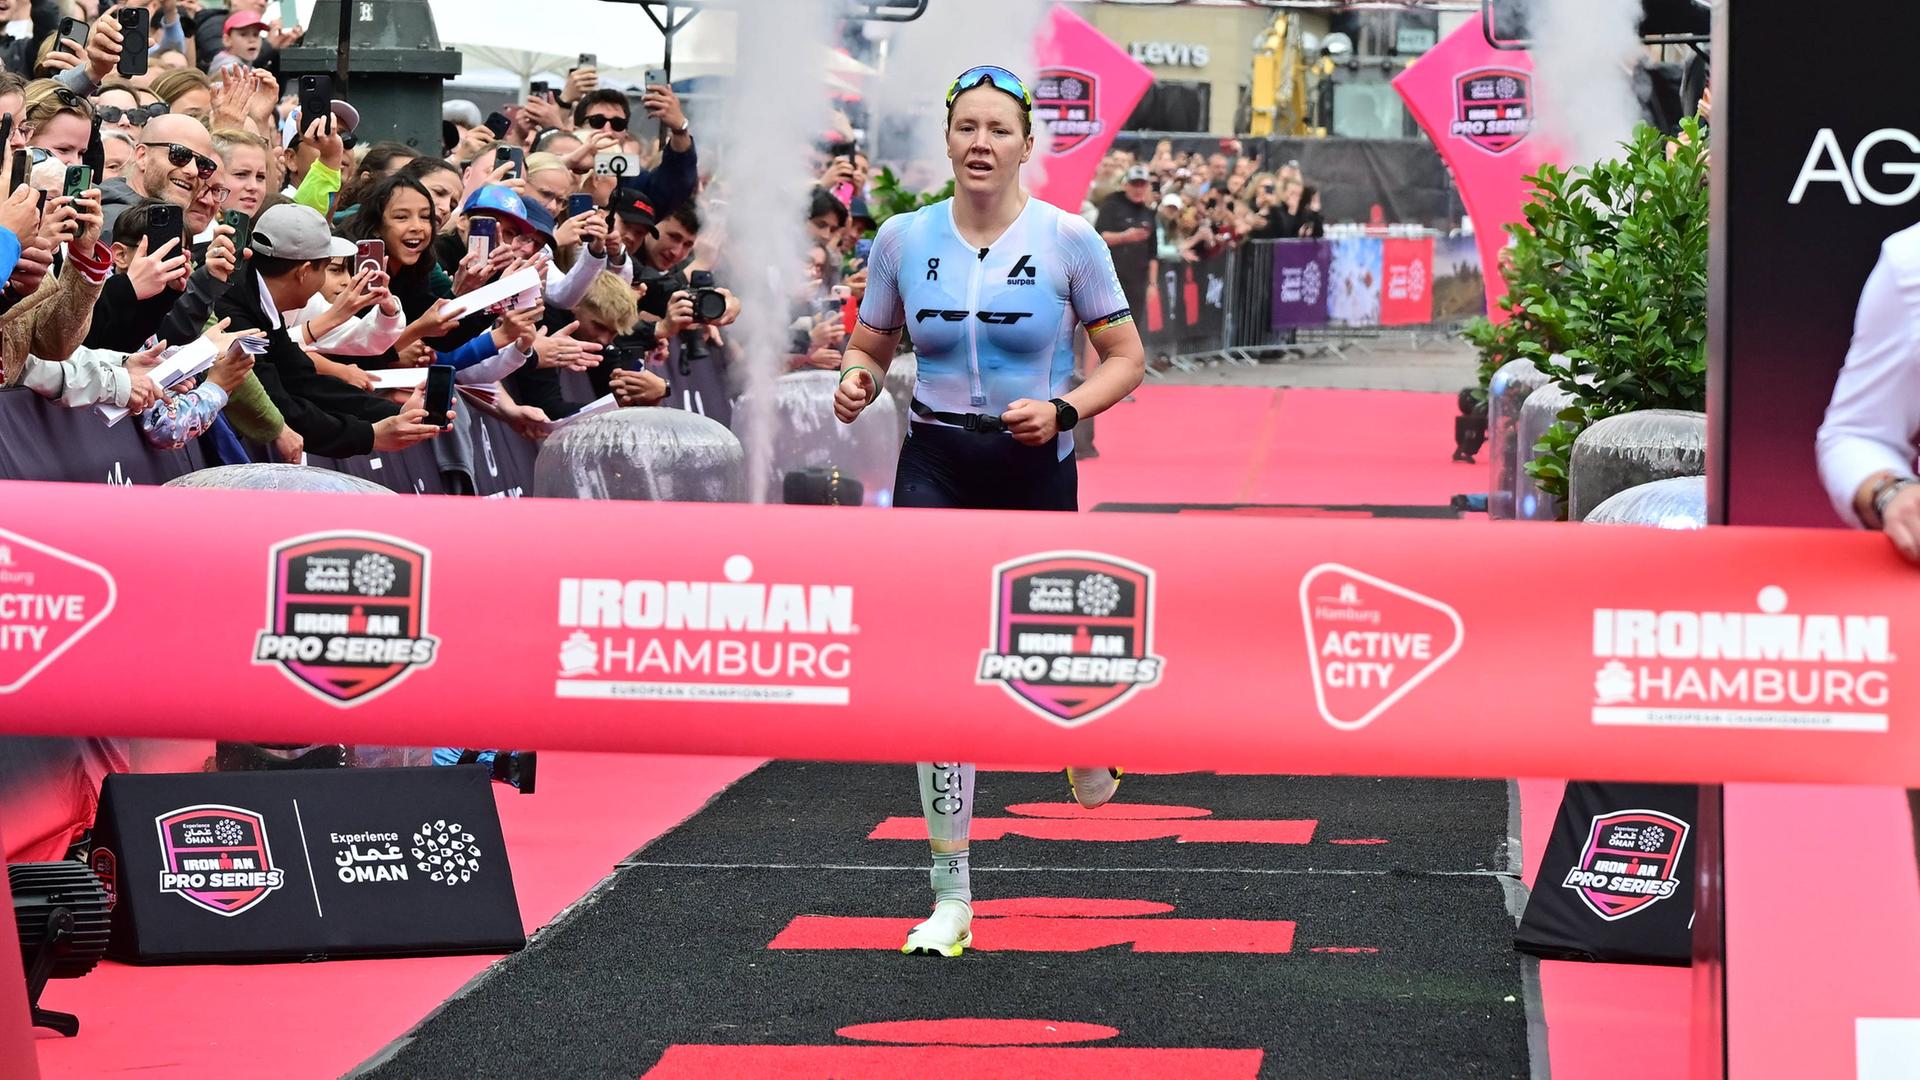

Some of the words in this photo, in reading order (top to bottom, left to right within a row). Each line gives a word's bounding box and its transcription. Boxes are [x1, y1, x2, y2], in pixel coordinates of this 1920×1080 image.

[1007, 278, 1036, 286] surpas
[915, 309, 1033, 325] FELT
[558, 555, 854, 634] IRONMAN
[294, 606, 400, 635] IRONMAN
[1315, 606, 1381, 625] Hamburg
[1593, 585, 1889, 663] IRONMAN
[257, 635, 323, 661] PRO
[324, 637, 434, 664] SERIES
[1018, 626, 1125, 656] IRONMAN
[1321, 630, 1432, 660] ACTIVE
[603, 636, 851, 679] HAMBURG
[981, 654, 1048, 681] PRO
[1049, 656, 1158, 683] SERIES
[1325, 661, 1394, 689] CITY
[1638, 666, 1888, 706] HAMBURG
[185, 836, 213, 844] OMAN
[330, 831, 399, 844] Experience
[1608, 838, 1635, 848] OMAN
[183, 853, 254, 871] IRONMAN
[338, 864, 409, 883] OMAN
[1594, 858, 1658, 877] IRONMAN
[164, 873, 205, 888] PRO
[209, 871, 280, 887] SERIES
[1568, 870, 1607, 888] PRO
[1607, 875, 1676, 896] SERIES
